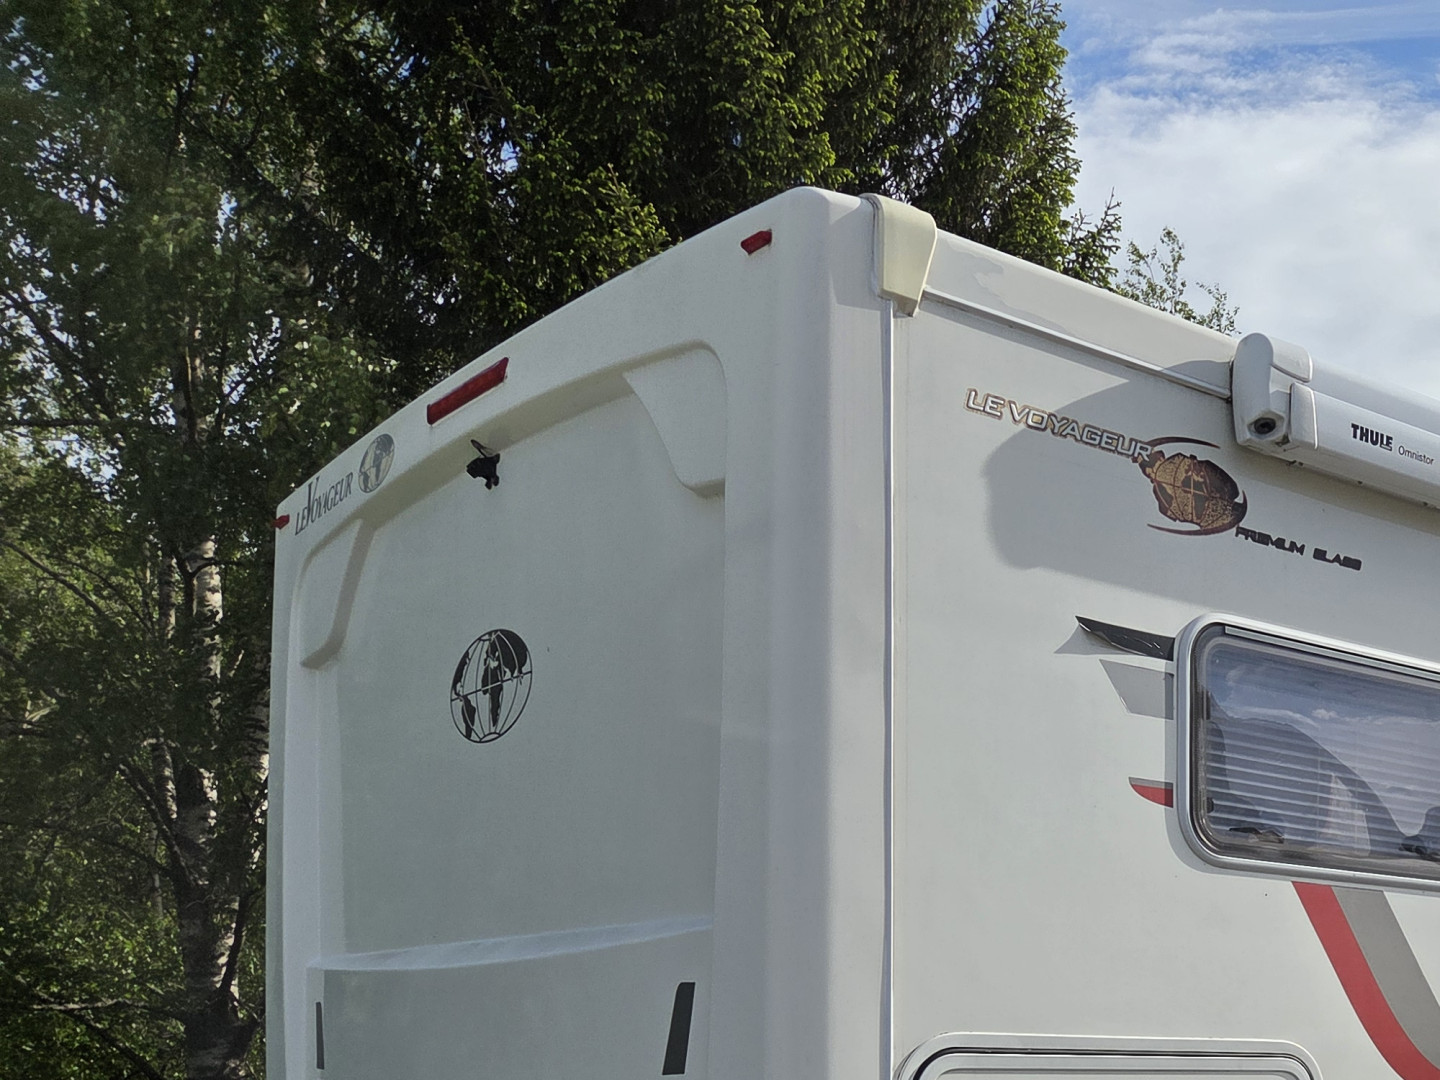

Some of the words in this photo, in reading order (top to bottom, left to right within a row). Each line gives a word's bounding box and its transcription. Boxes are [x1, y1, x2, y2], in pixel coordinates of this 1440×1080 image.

[966, 388, 1005, 420] LE
[1008, 399, 1153, 462] VOYAGEUR
[1351, 422, 1394, 452] THULE
[1398, 445, 1435, 466] Omnistor
